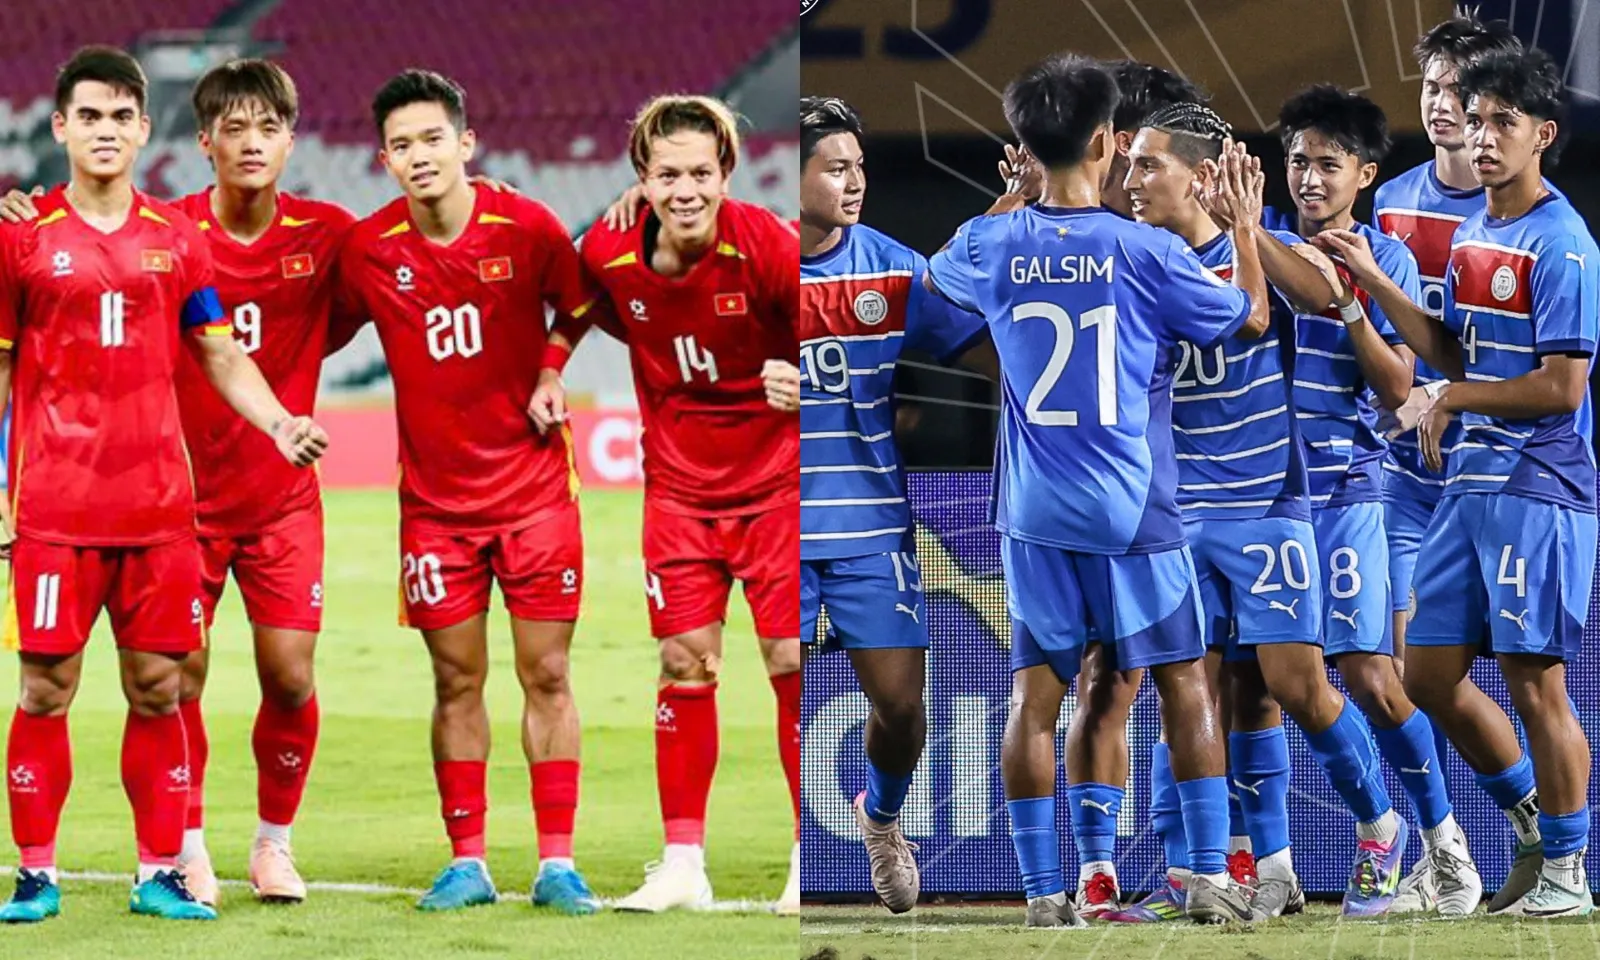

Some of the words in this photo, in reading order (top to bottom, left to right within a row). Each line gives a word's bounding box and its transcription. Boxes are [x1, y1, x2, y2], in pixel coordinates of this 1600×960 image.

[1010, 255, 1115, 284] GALSIM
[101, 291, 124, 348] 11
[234, 301, 261, 353] 9
[425, 303, 482, 361] 20
[1457, 311, 1476, 364] 4
[673, 335, 719, 383] 14
[800, 341, 850, 393] 19
[1012, 301, 1118, 426] 21
[1173, 340, 1226, 386] 20
[404, 553, 447, 605] 20
[645, 572, 665, 610] 4
[1242, 539, 1311, 594] 20
[1329, 546, 1362, 599] 8
[1497, 544, 1526, 598] 4
[34, 573, 61, 630] 11
